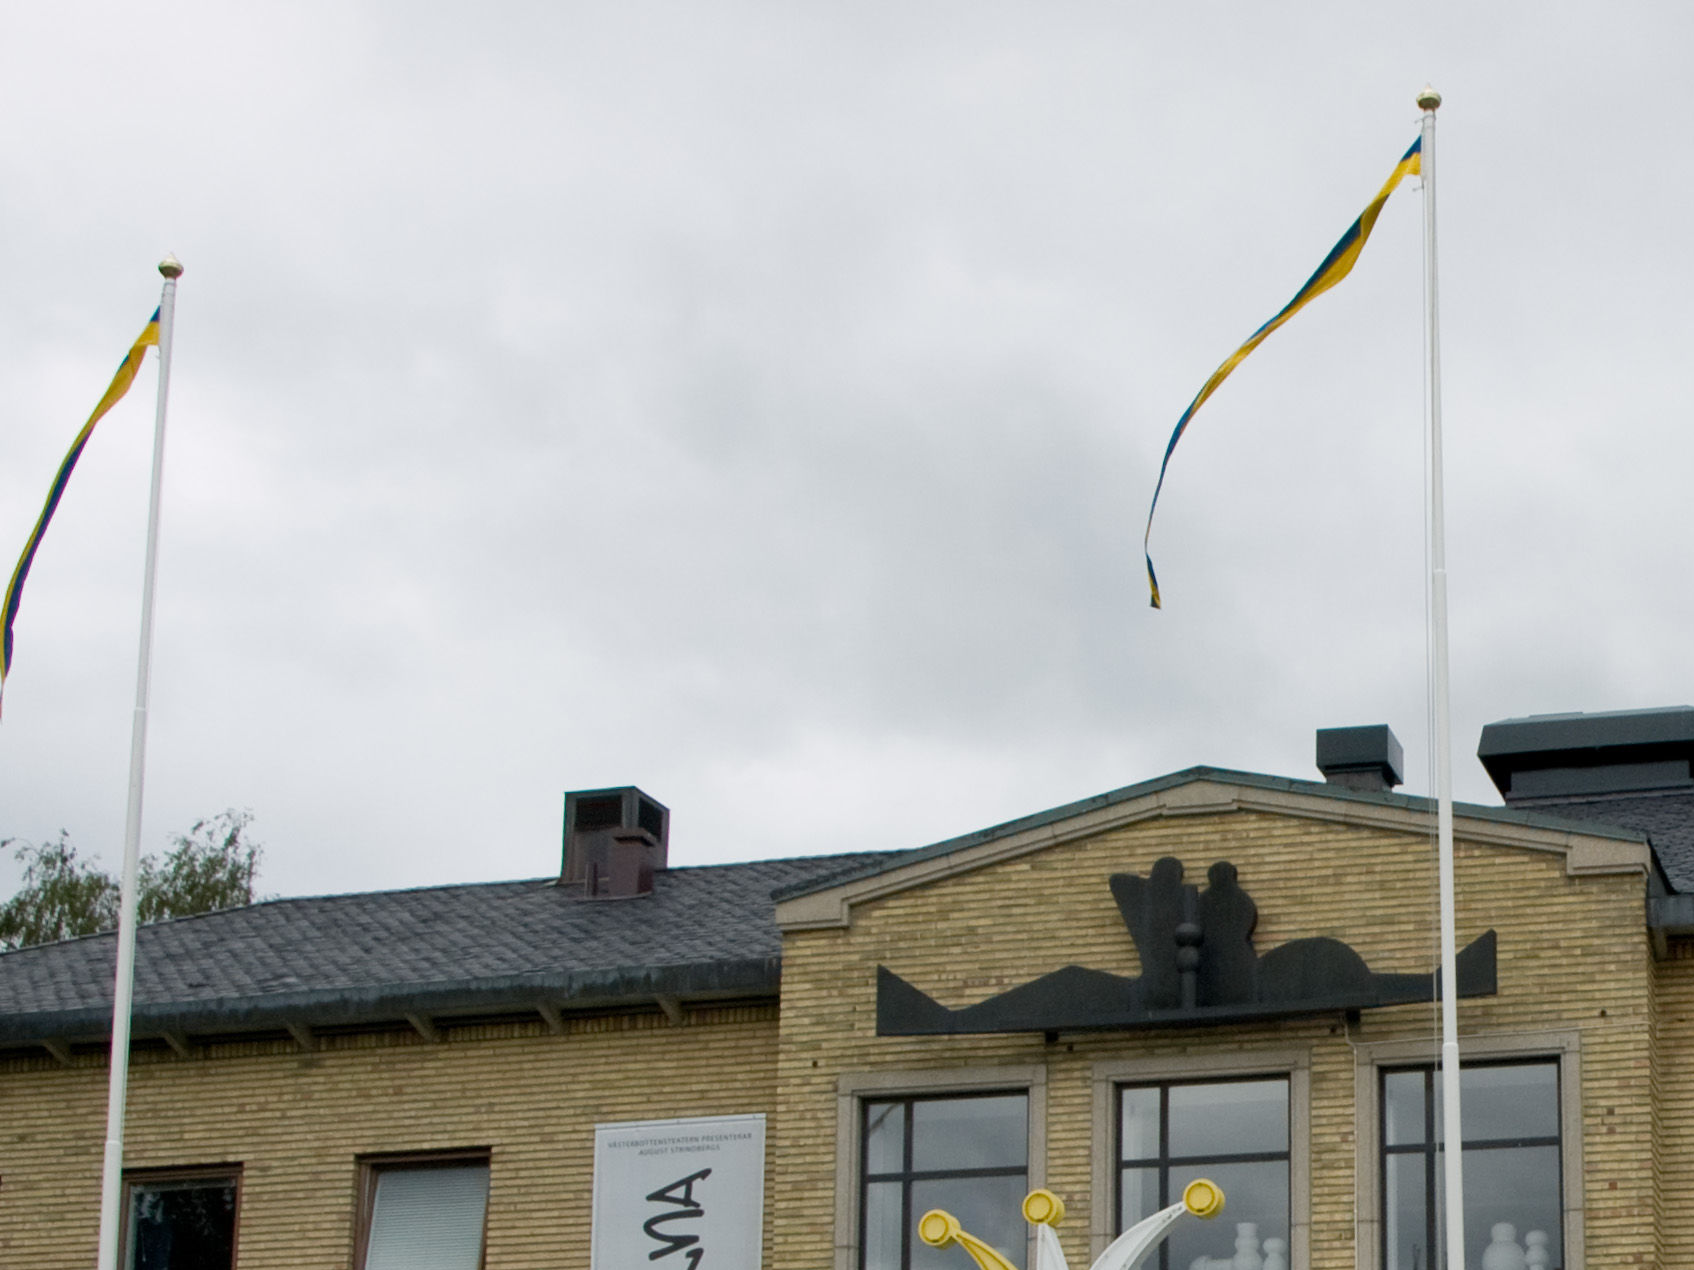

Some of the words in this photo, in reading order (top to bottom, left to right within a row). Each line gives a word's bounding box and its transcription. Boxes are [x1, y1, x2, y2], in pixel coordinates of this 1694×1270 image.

[608, 1136, 700, 1149] VÄSTERBOTTENSTEATERN
[701, 1132, 752, 1143] PRESENTERAR
[638, 1147, 668, 1156] AUGUST
[671, 1144, 720, 1154] STRINDBERGS
